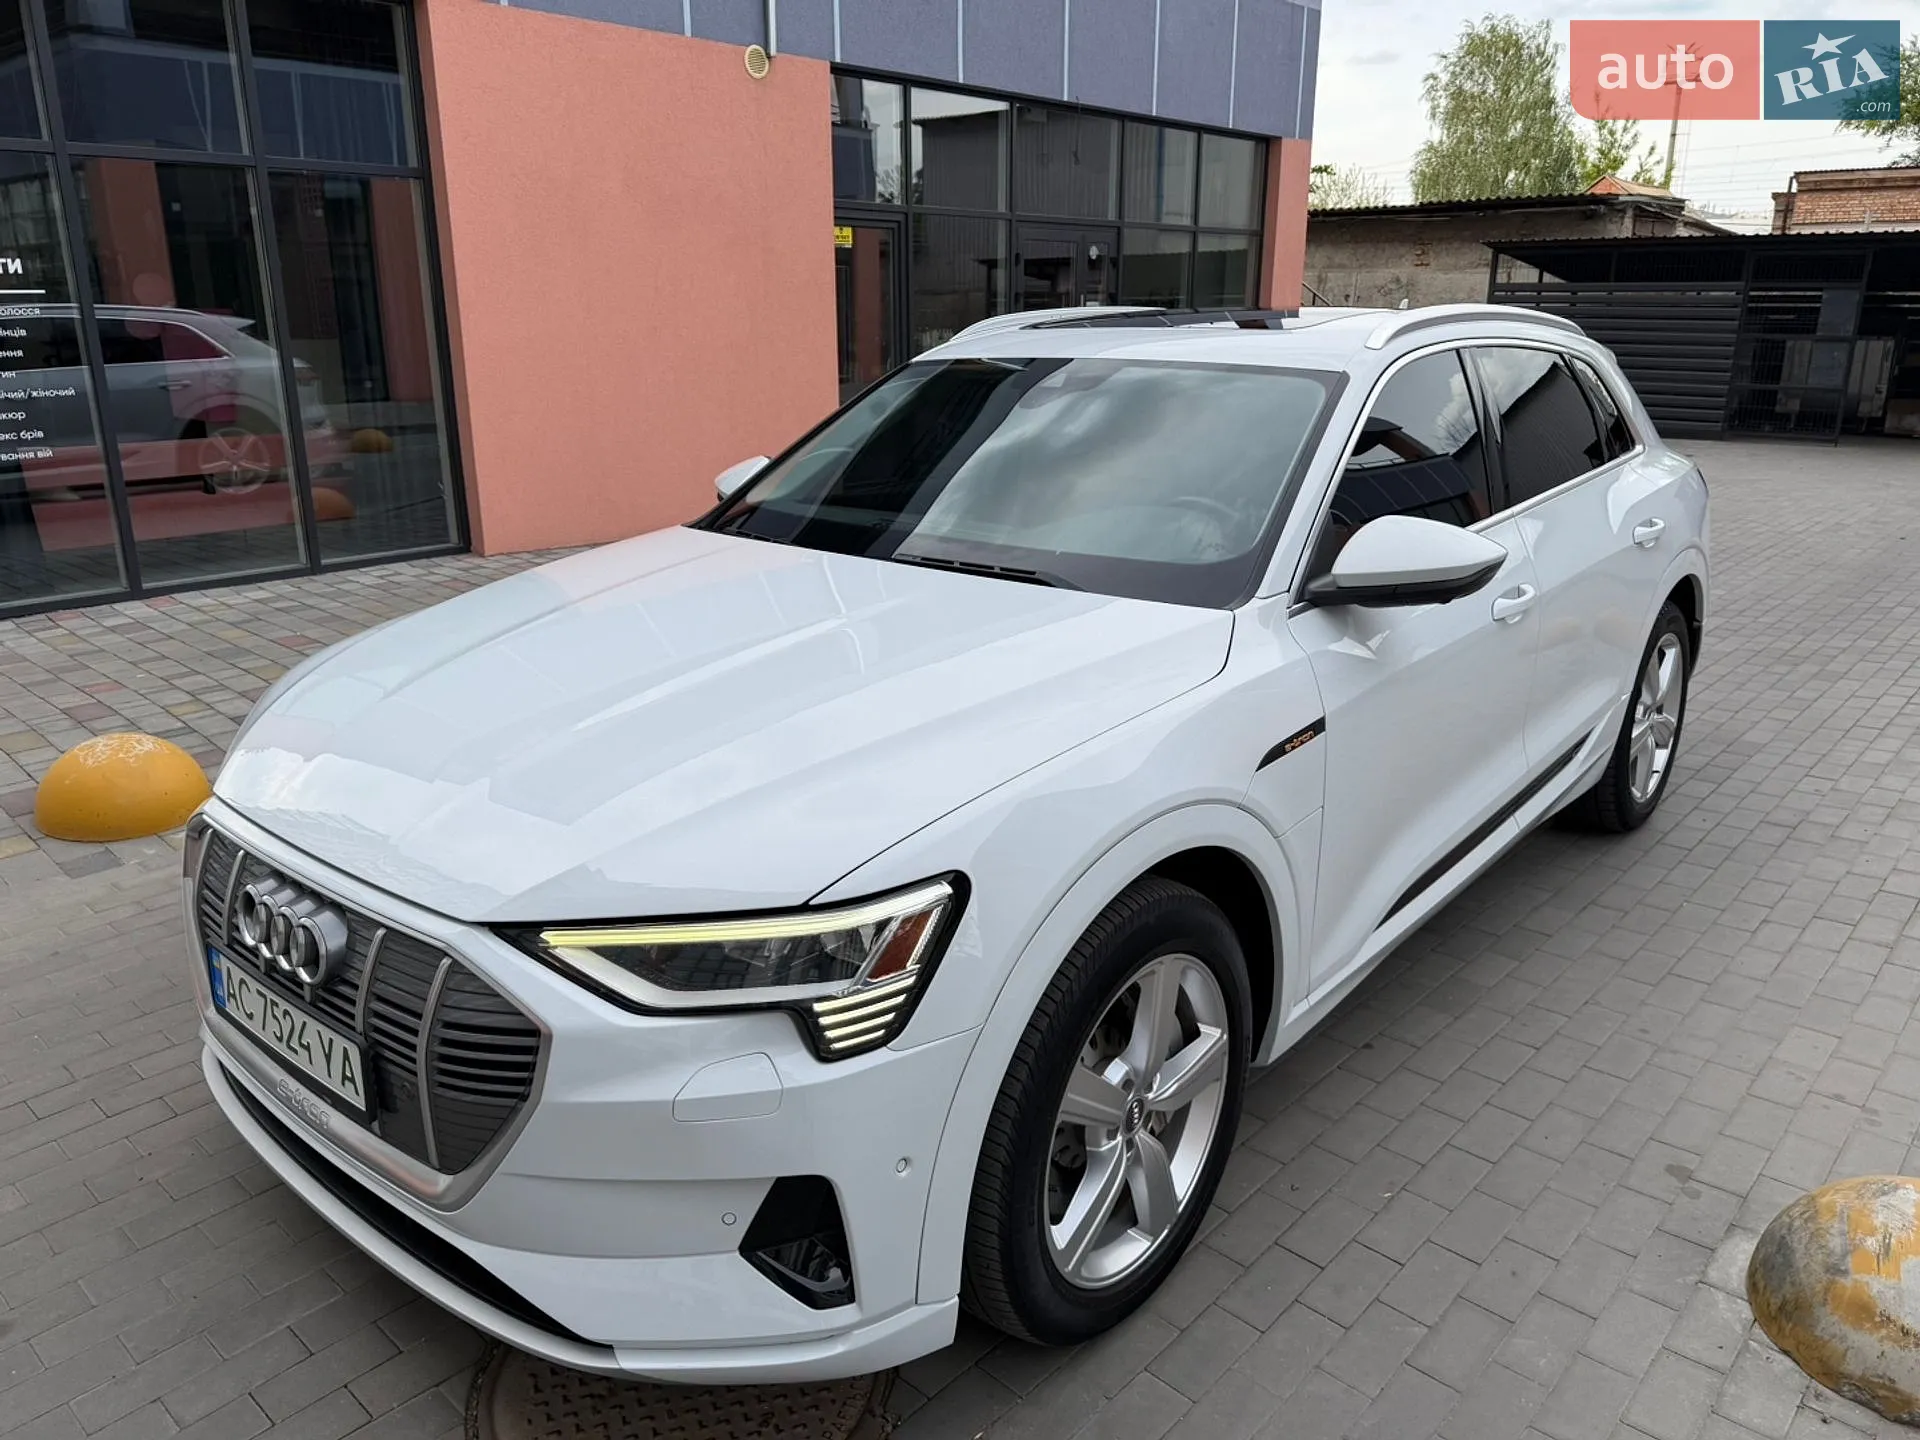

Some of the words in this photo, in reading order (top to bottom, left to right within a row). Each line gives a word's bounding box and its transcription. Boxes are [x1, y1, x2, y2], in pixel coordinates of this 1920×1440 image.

[20, 429, 44, 440] брів
[37, 448, 53, 459] вій
[226, 965, 254, 1022] AC
[256, 989, 313, 1066] 7524
[317, 1028, 361, 1098] YA
